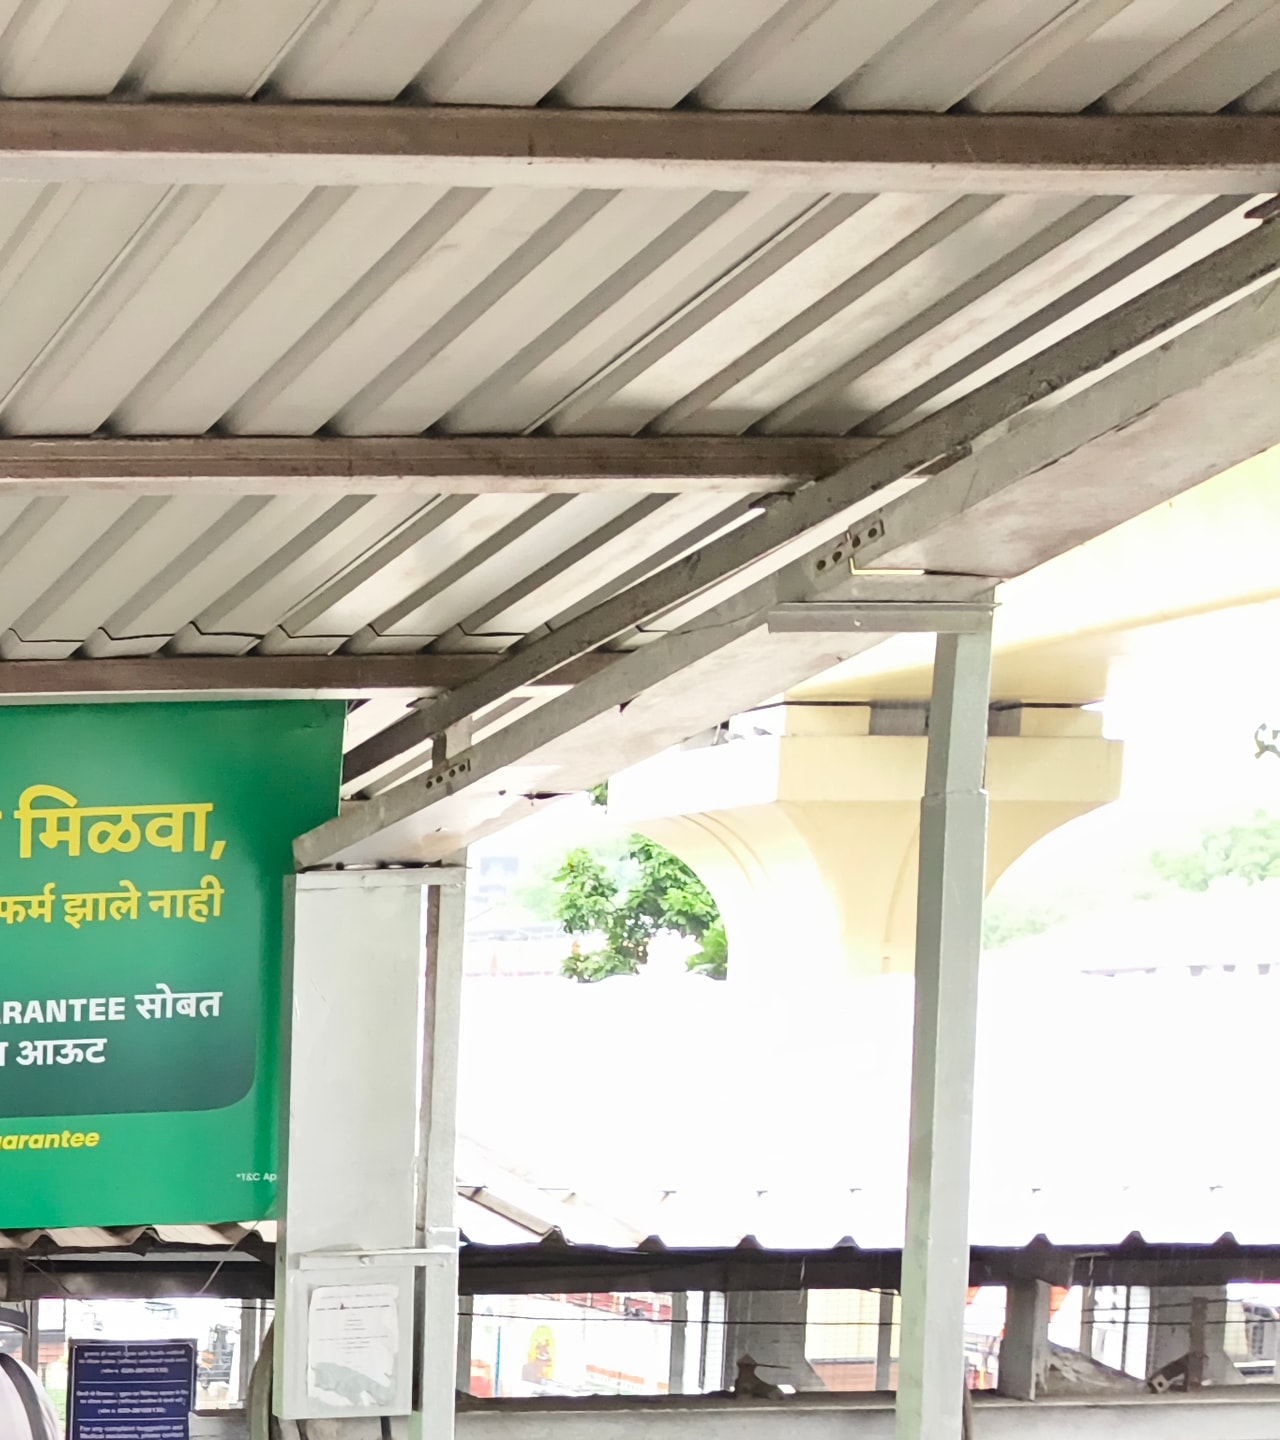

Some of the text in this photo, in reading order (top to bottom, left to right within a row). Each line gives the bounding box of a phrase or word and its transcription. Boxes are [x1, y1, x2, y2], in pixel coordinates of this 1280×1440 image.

[13, 784, 228, 861] मिळवा,
[61, 880, 143, 930] झाले
[148, 874, 225, 923] नाही
[134, 982, 224, 1020] सोबत
[15, 1038, 108, 1066] आऊट
